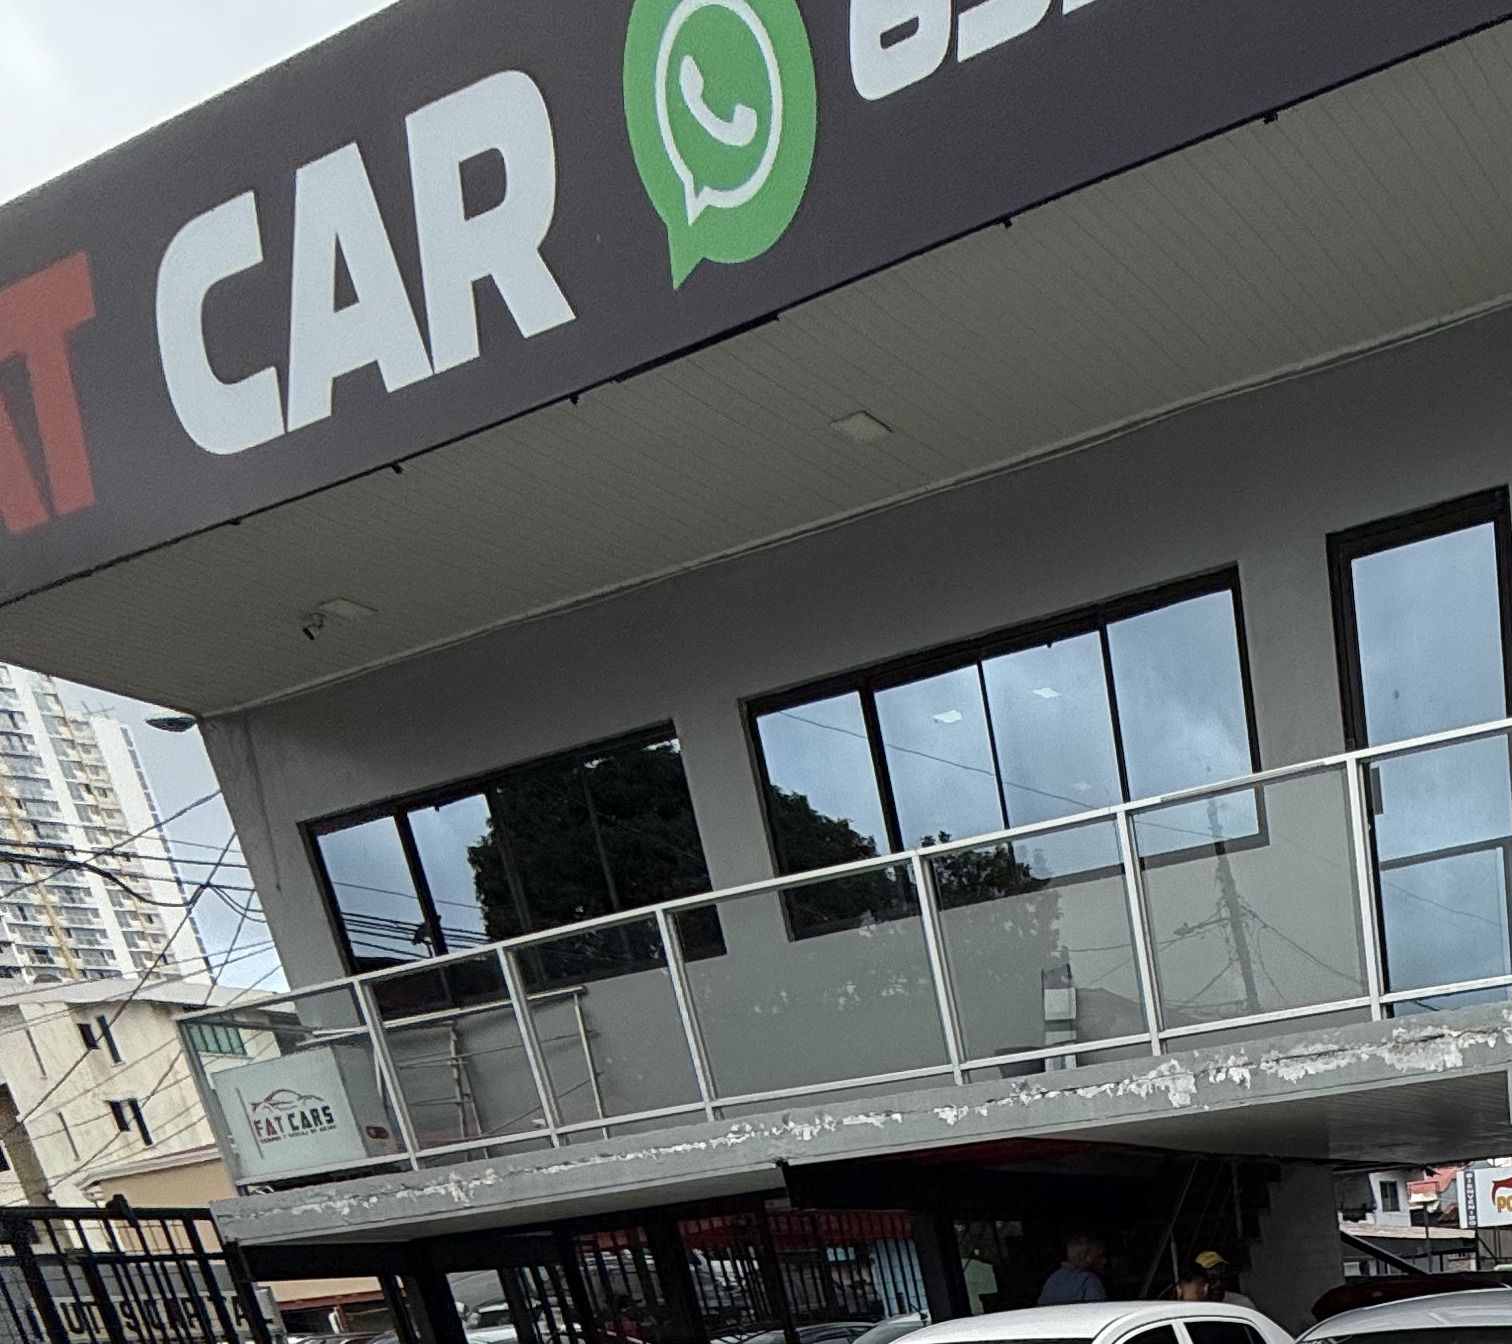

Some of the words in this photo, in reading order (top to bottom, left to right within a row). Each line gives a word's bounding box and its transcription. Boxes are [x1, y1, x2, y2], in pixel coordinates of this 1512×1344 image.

[156, 70, 576, 456] CAR
[253, 1116, 285, 1137] FAT
[287, 1105, 335, 1131] CARS
